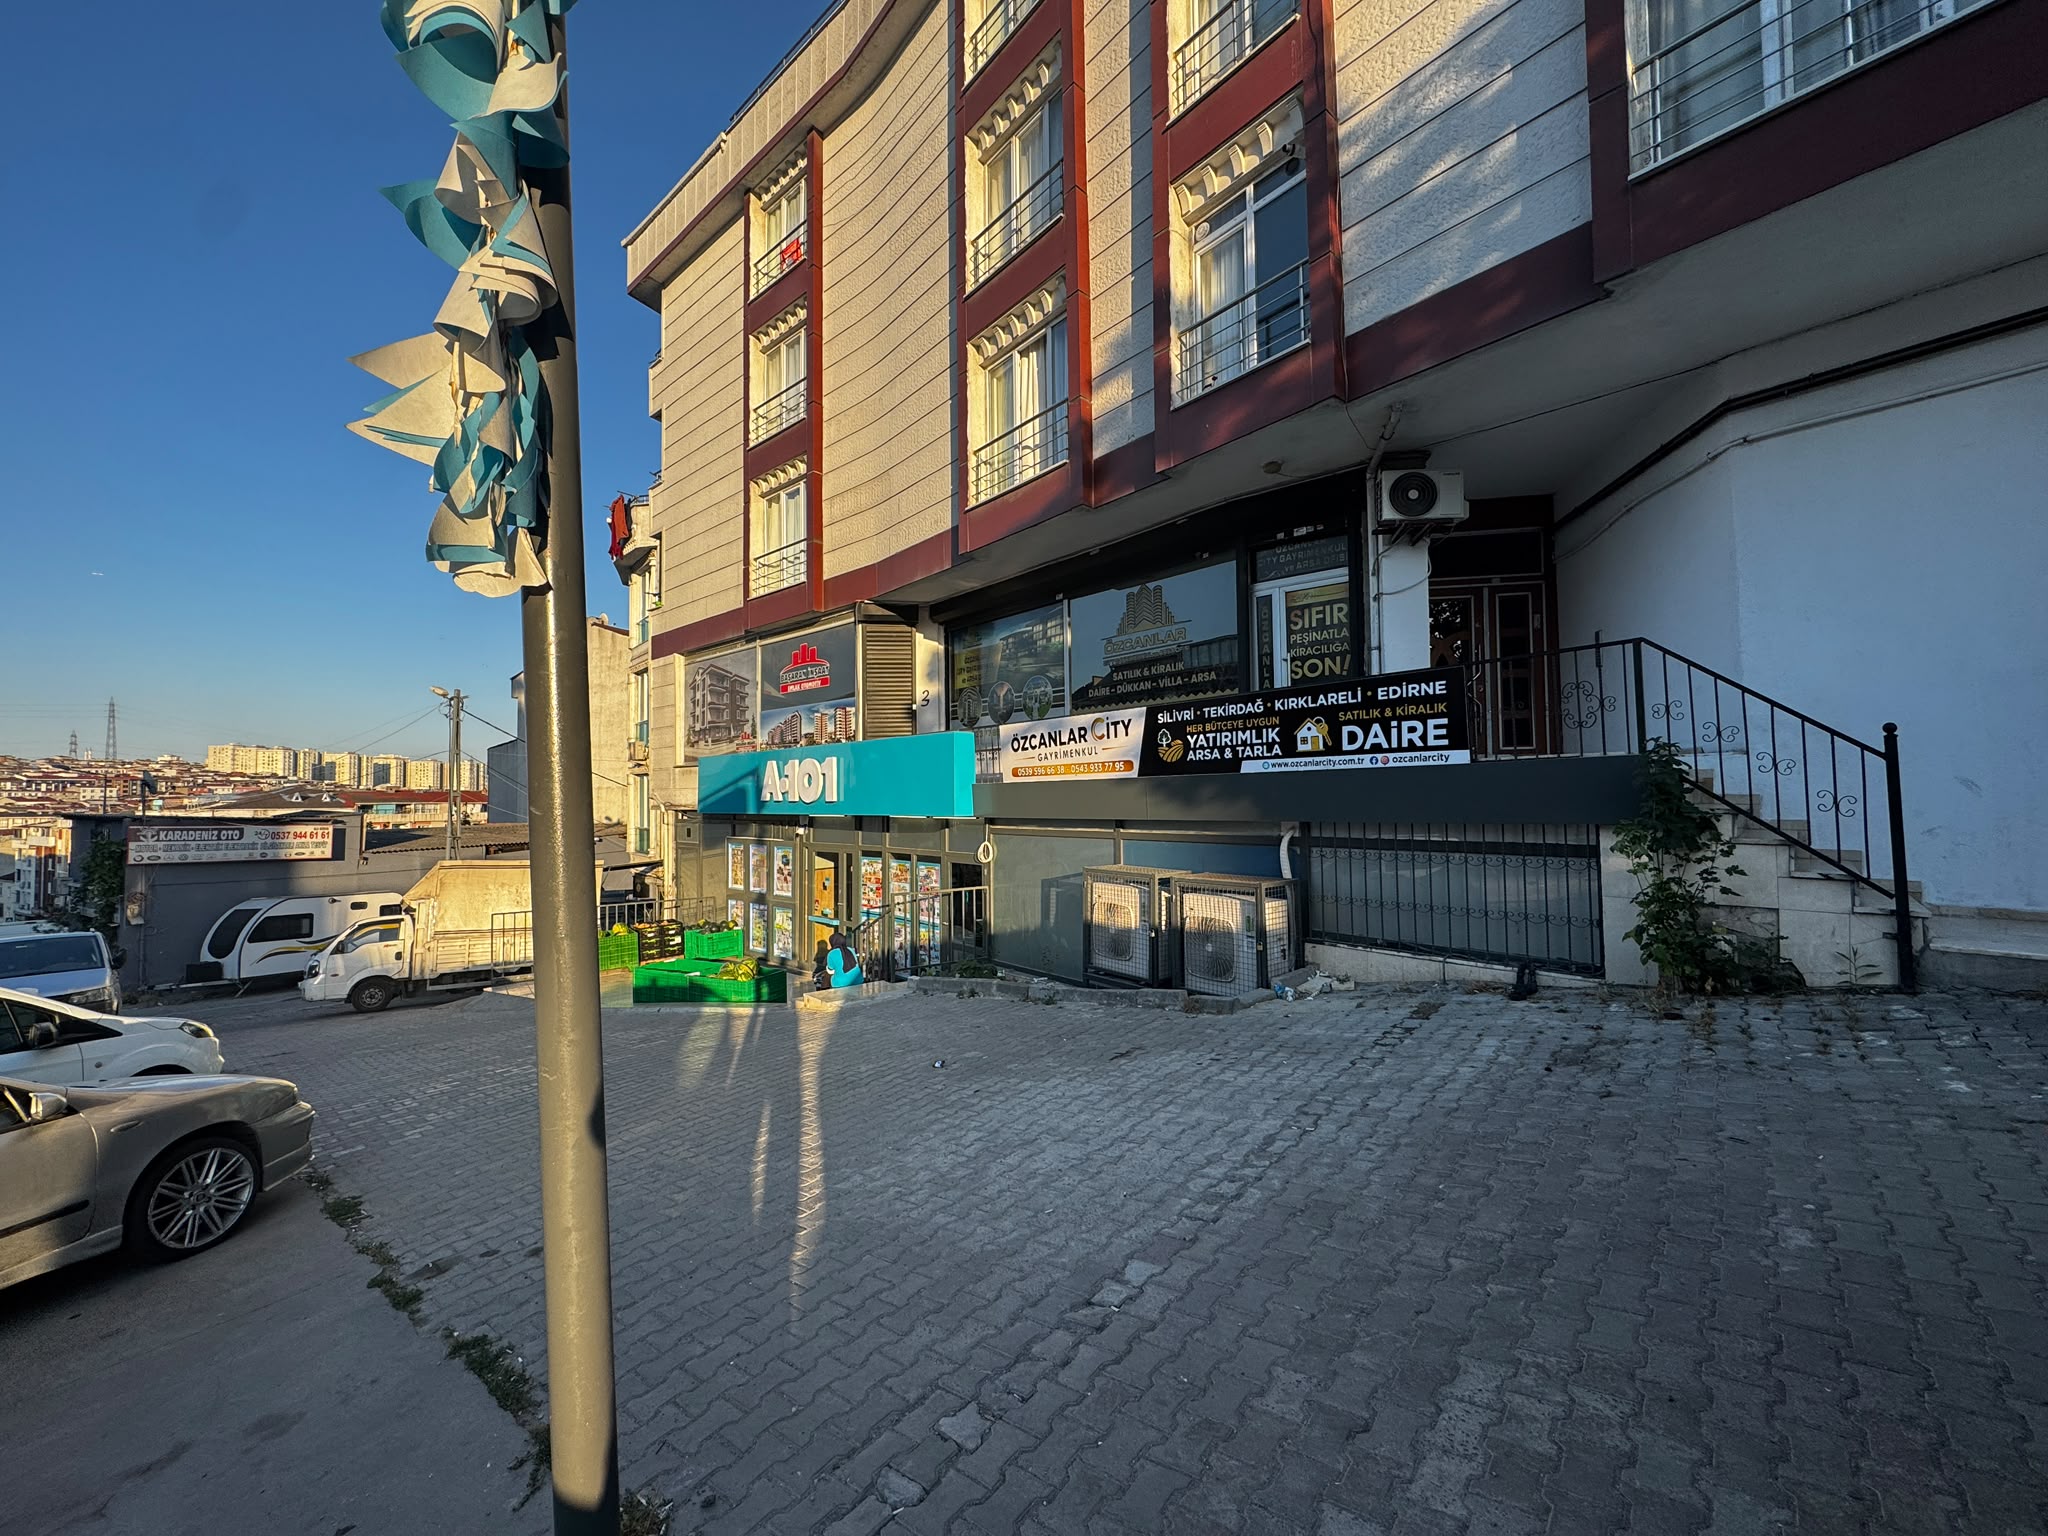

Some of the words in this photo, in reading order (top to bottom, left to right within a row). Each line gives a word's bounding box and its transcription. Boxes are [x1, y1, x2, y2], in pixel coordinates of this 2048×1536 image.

[1290, 602, 1348, 631] SIFIR
[1104, 626, 1187, 655] ÖZCANLAR
[1290, 627, 1349, 645] PEŞİNATLA
[1290, 641, 1350, 657] KİRACILIĞA
[1112, 668, 1142, 681] SATILIK
[1143, 667, 1150, 676] &
[1151, 661, 1184, 674] KİRALIK
[1291, 654, 1351, 680] SON!
[1116, 680, 1151, 693] DÜKKAN
[1158, 675, 1183, 689] VİLLA
[1191, 671, 1216, 684] ARSA
[1157, 707, 1194, 724] SİLİVRİ
[1203, 698, 1264, 718] TEKİRDAĞ
[1274, 687, 1362, 711] KIRKLARELİ
[1377, 680, 1447, 700] EDİRNE
[1338, 708, 1381, 721] SATILIK
[1384, 708, 1392, 717] &
[1396, 702, 1447, 716] KİRALIK
[1186, 724, 1203, 733] HER
[1205, 720, 1244, 732] BÜTÇEYE
[1246, 716, 1279, 728] UYGUN
[1011, 726, 1088, 752] ÖZCANLAR
[1187, 727, 1280, 749] YATIRIMLIK
[1037, 746, 1098, 762] GAYRİMENKUL
[1187, 748, 1221, 761] ARSA
[1224, 749, 1233, 759] &
[1236, 744, 1282, 758] TARLA
[1392, 753, 1450, 764] ozcanlarcity
[1017, 767, 1033, 777] 0539
[1033, 766, 1046, 776] 596
[1056, 765, 1065, 774] 38
[1070, 763, 1088, 773] 0543
[1089, 762, 1103, 772] 933
[1104, 762, 1112, 771] 77
[1115, 761, 1125, 771] 95
[1271, 757, 1365, 769] www.ozcanlarcity.com.tr
[159, 829, 218, 841] KARADENİZ
[220, 829, 240, 840] OTO
[271, 831, 291, 840] 0537
[292, 831, 308, 839] 944
[309, 831, 319, 839] 61
[320, 831, 330, 839] 61
